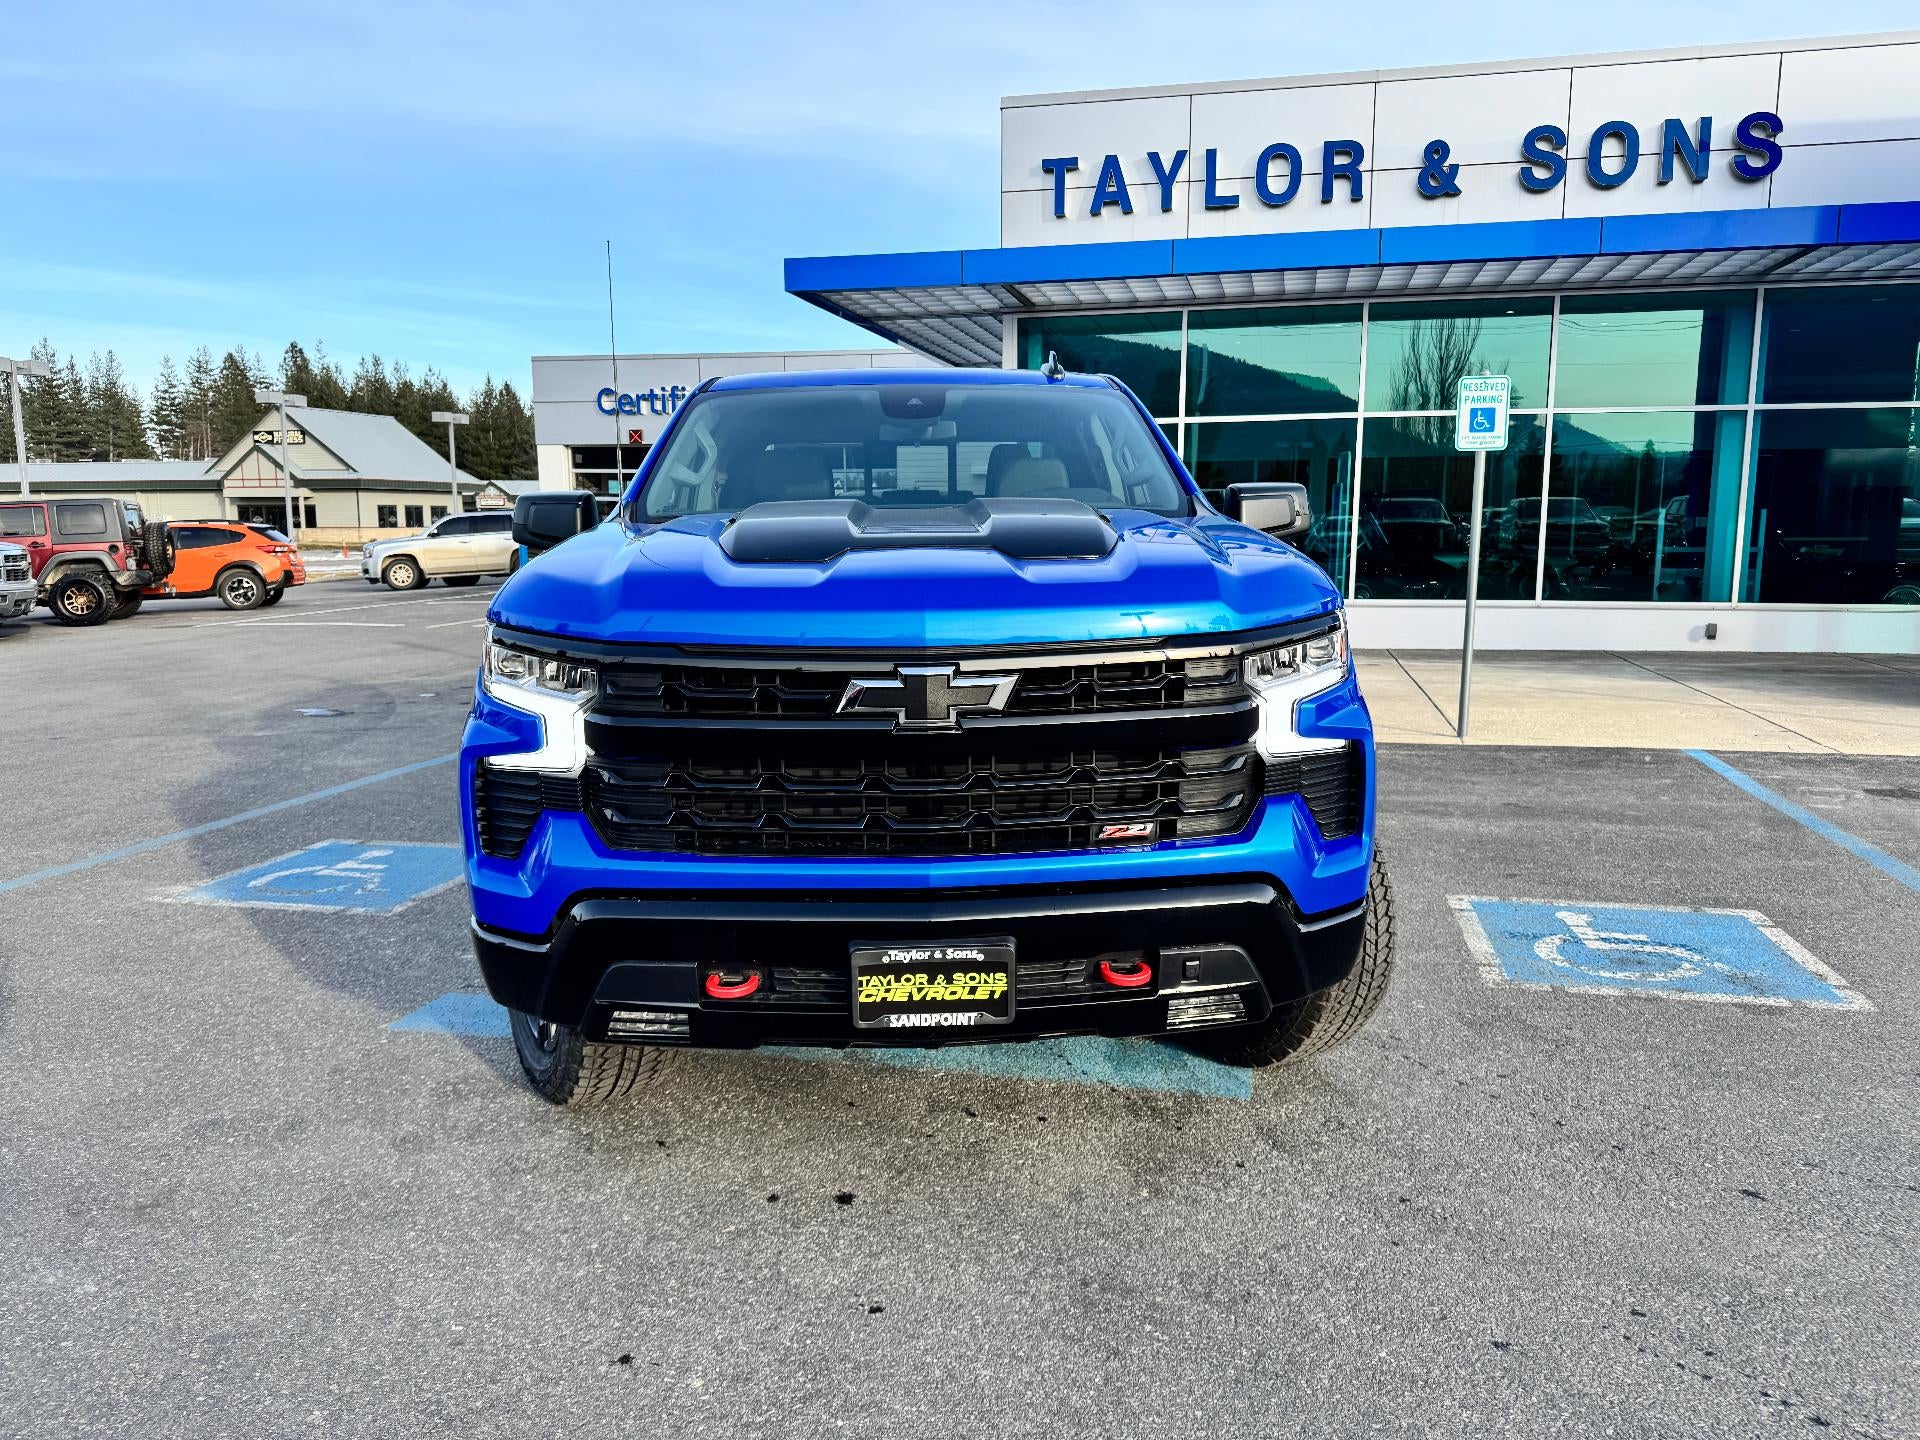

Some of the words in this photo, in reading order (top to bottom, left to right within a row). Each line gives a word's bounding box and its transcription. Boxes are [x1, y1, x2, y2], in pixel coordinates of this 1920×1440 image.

[1042, 140, 1365, 218] TAYLOR
[1417, 139, 1462, 199] &
[1519, 111, 1784, 193] SONS
[1463, 382, 1506, 392] RESERVED
[1464, 394, 1503, 405] PARKING
[888, 950, 931, 963] Taylor
[934, 951, 943, 959] &
[946, 950, 979, 961] Sons
[858, 974, 928, 988] TAYLOR
[934, 974, 947, 986] &
[953, 972, 1008, 985] SONS
[858, 986, 1008, 1003] CHEVROLET
[889, 1012, 979, 1028] SANDPOINT
